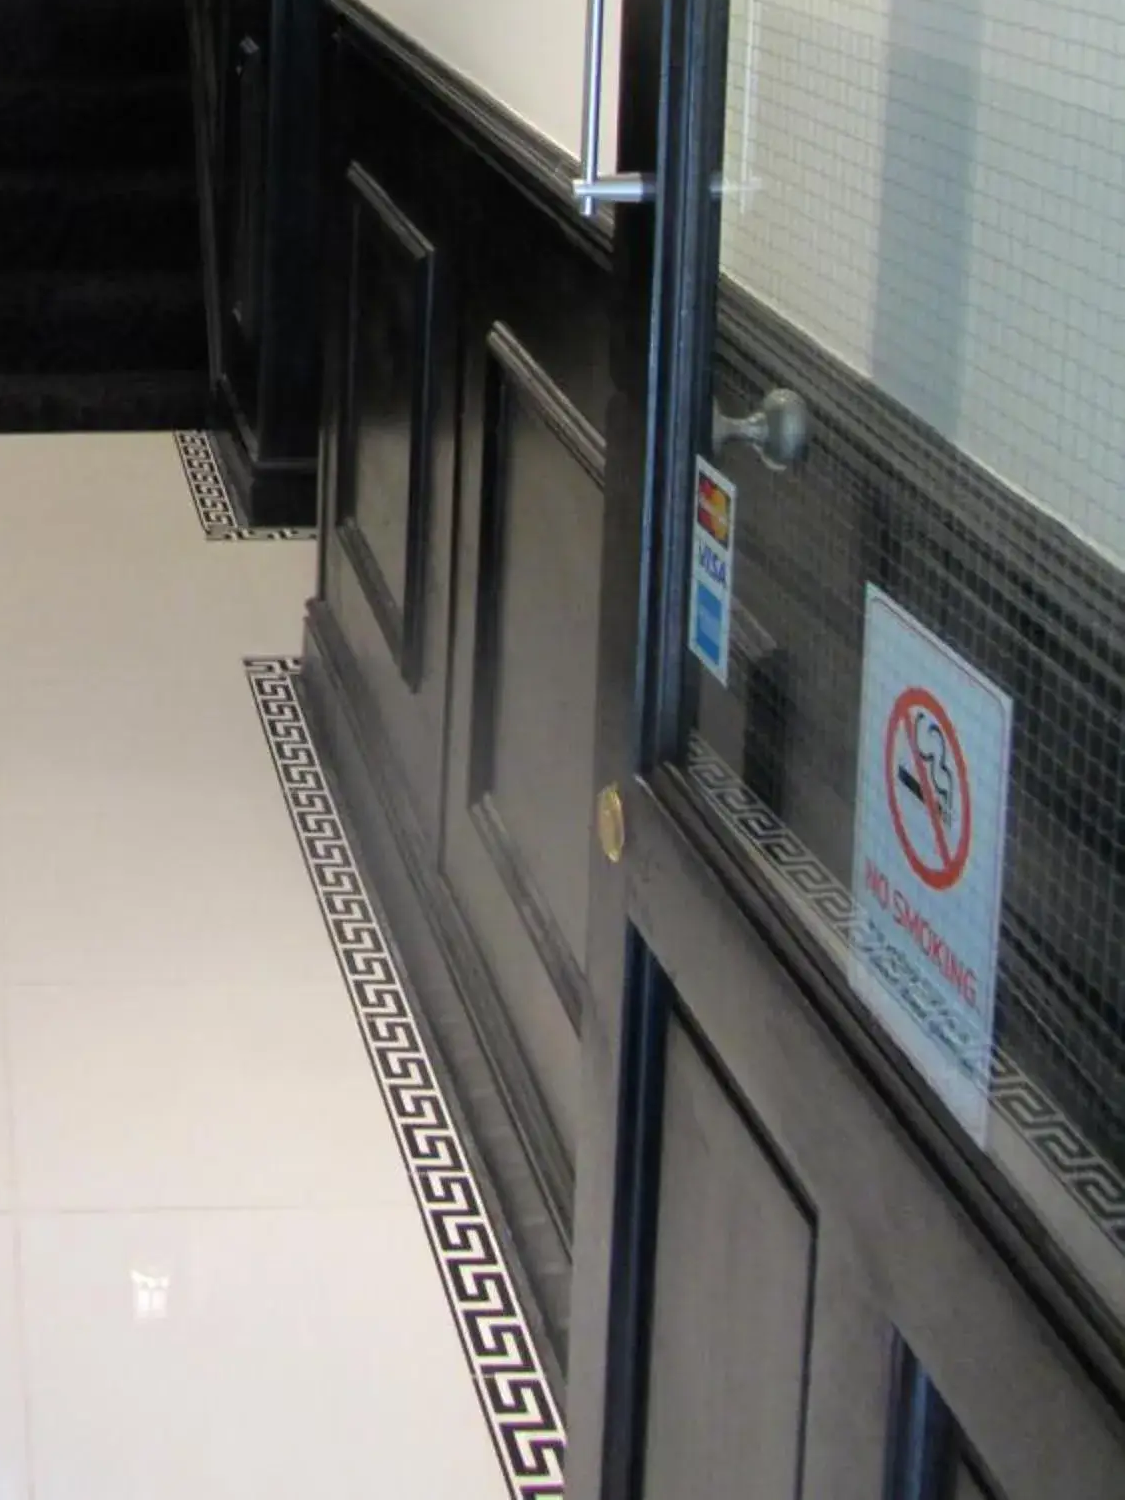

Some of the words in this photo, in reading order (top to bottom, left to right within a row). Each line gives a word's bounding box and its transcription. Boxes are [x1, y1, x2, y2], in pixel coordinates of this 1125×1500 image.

[698, 539, 727, 587] VISA
[864, 856, 889, 910] NO
[892, 888, 977, 1007] SMOKING
